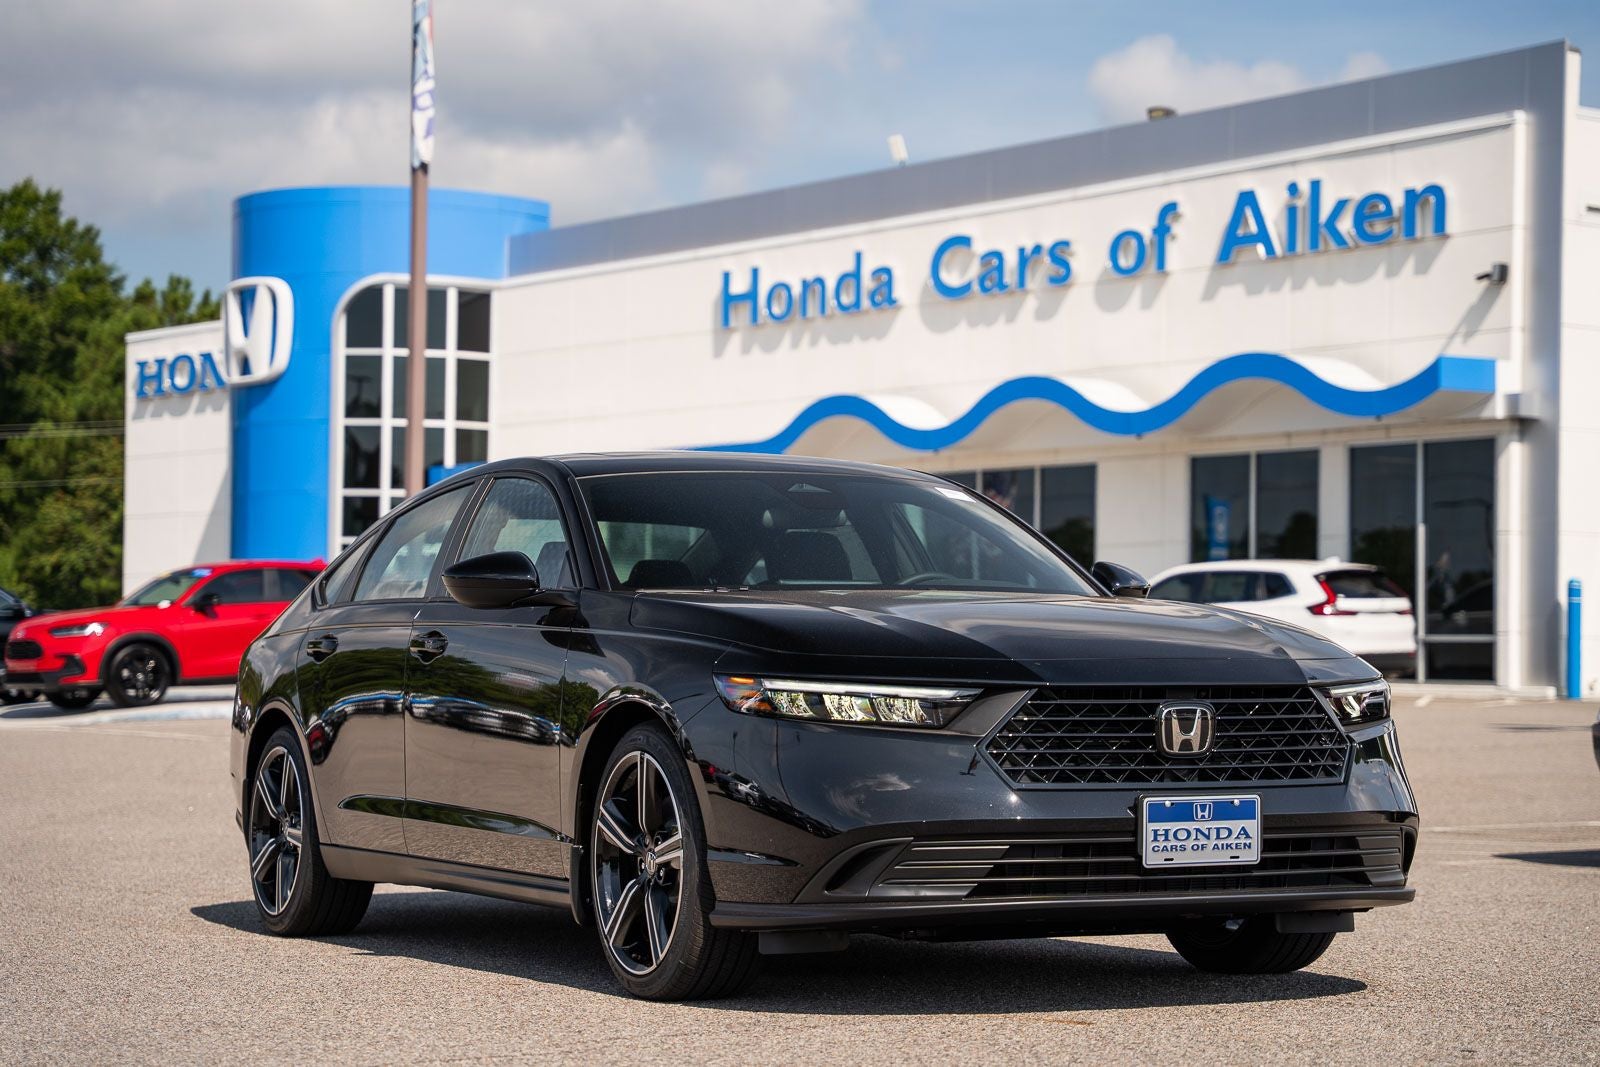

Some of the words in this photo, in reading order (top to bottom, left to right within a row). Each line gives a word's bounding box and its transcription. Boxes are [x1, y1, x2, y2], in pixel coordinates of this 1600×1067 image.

[721, 251, 898, 329] Honda
[931, 235, 1072, 299] Cars
[1109, 202, 1178, 276] of
[1217, 180, 1447, 265] Aiken
[1151, 826, 1252, 842] HONDA
[1151, 843, 1187, 853] CARS
[1191, 843, 1208, 851] OF
[1211, 842, 1252, 851] AIKEN
